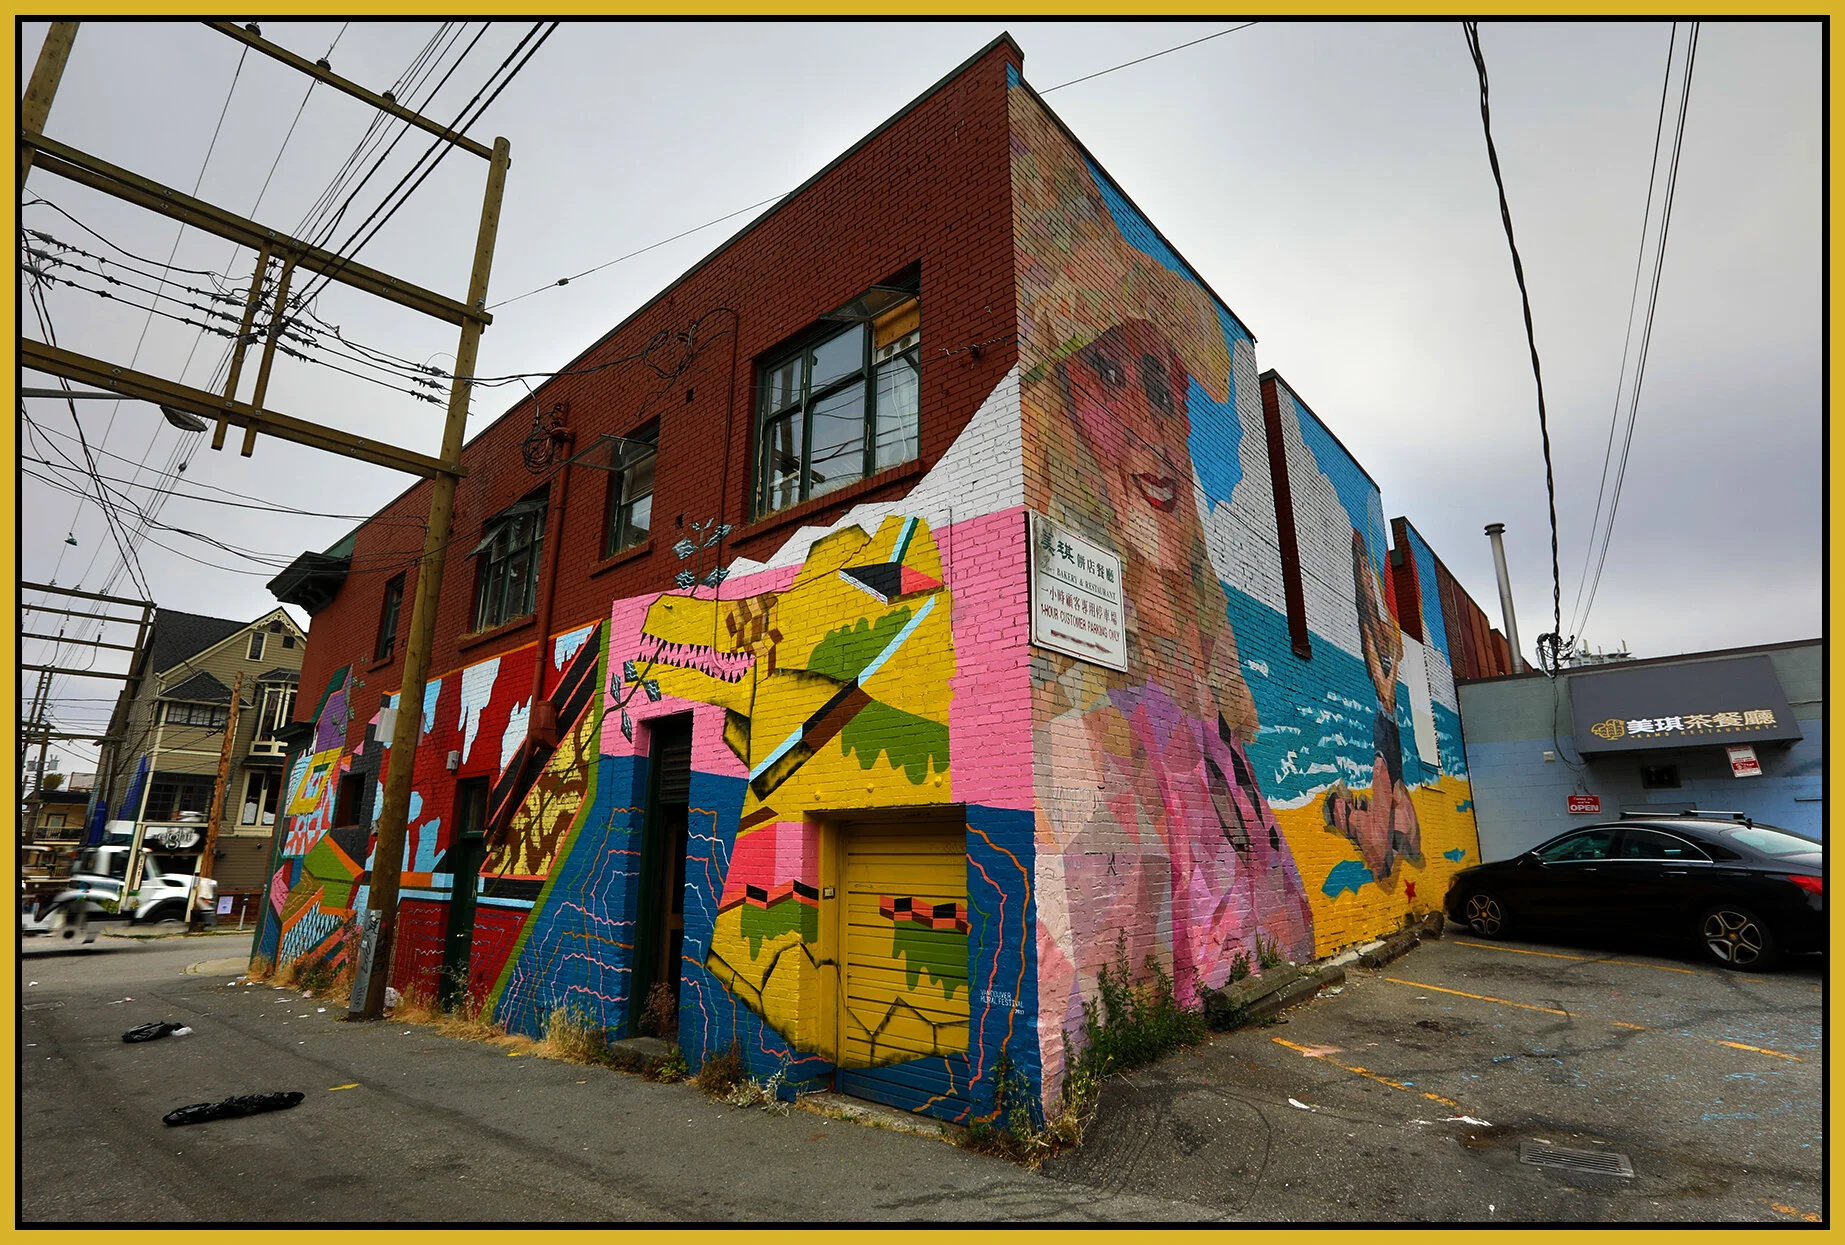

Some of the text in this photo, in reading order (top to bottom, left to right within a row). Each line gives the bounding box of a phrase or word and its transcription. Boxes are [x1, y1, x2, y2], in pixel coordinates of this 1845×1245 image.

[1056, 567, 1078, 585] BAKERY
[1085, 580, 1116, 601] RESTAURANT
[1040, 603, 1120, 642] 1-HOUR CUSTOMER PARKING ONLY
[1626, 708, 1777, 735] 美琪茶餐廳
[980, 989, 1012, 999] VANCOUVER
[980, 995, 1024, 1008] MURAL FESTIVAL
